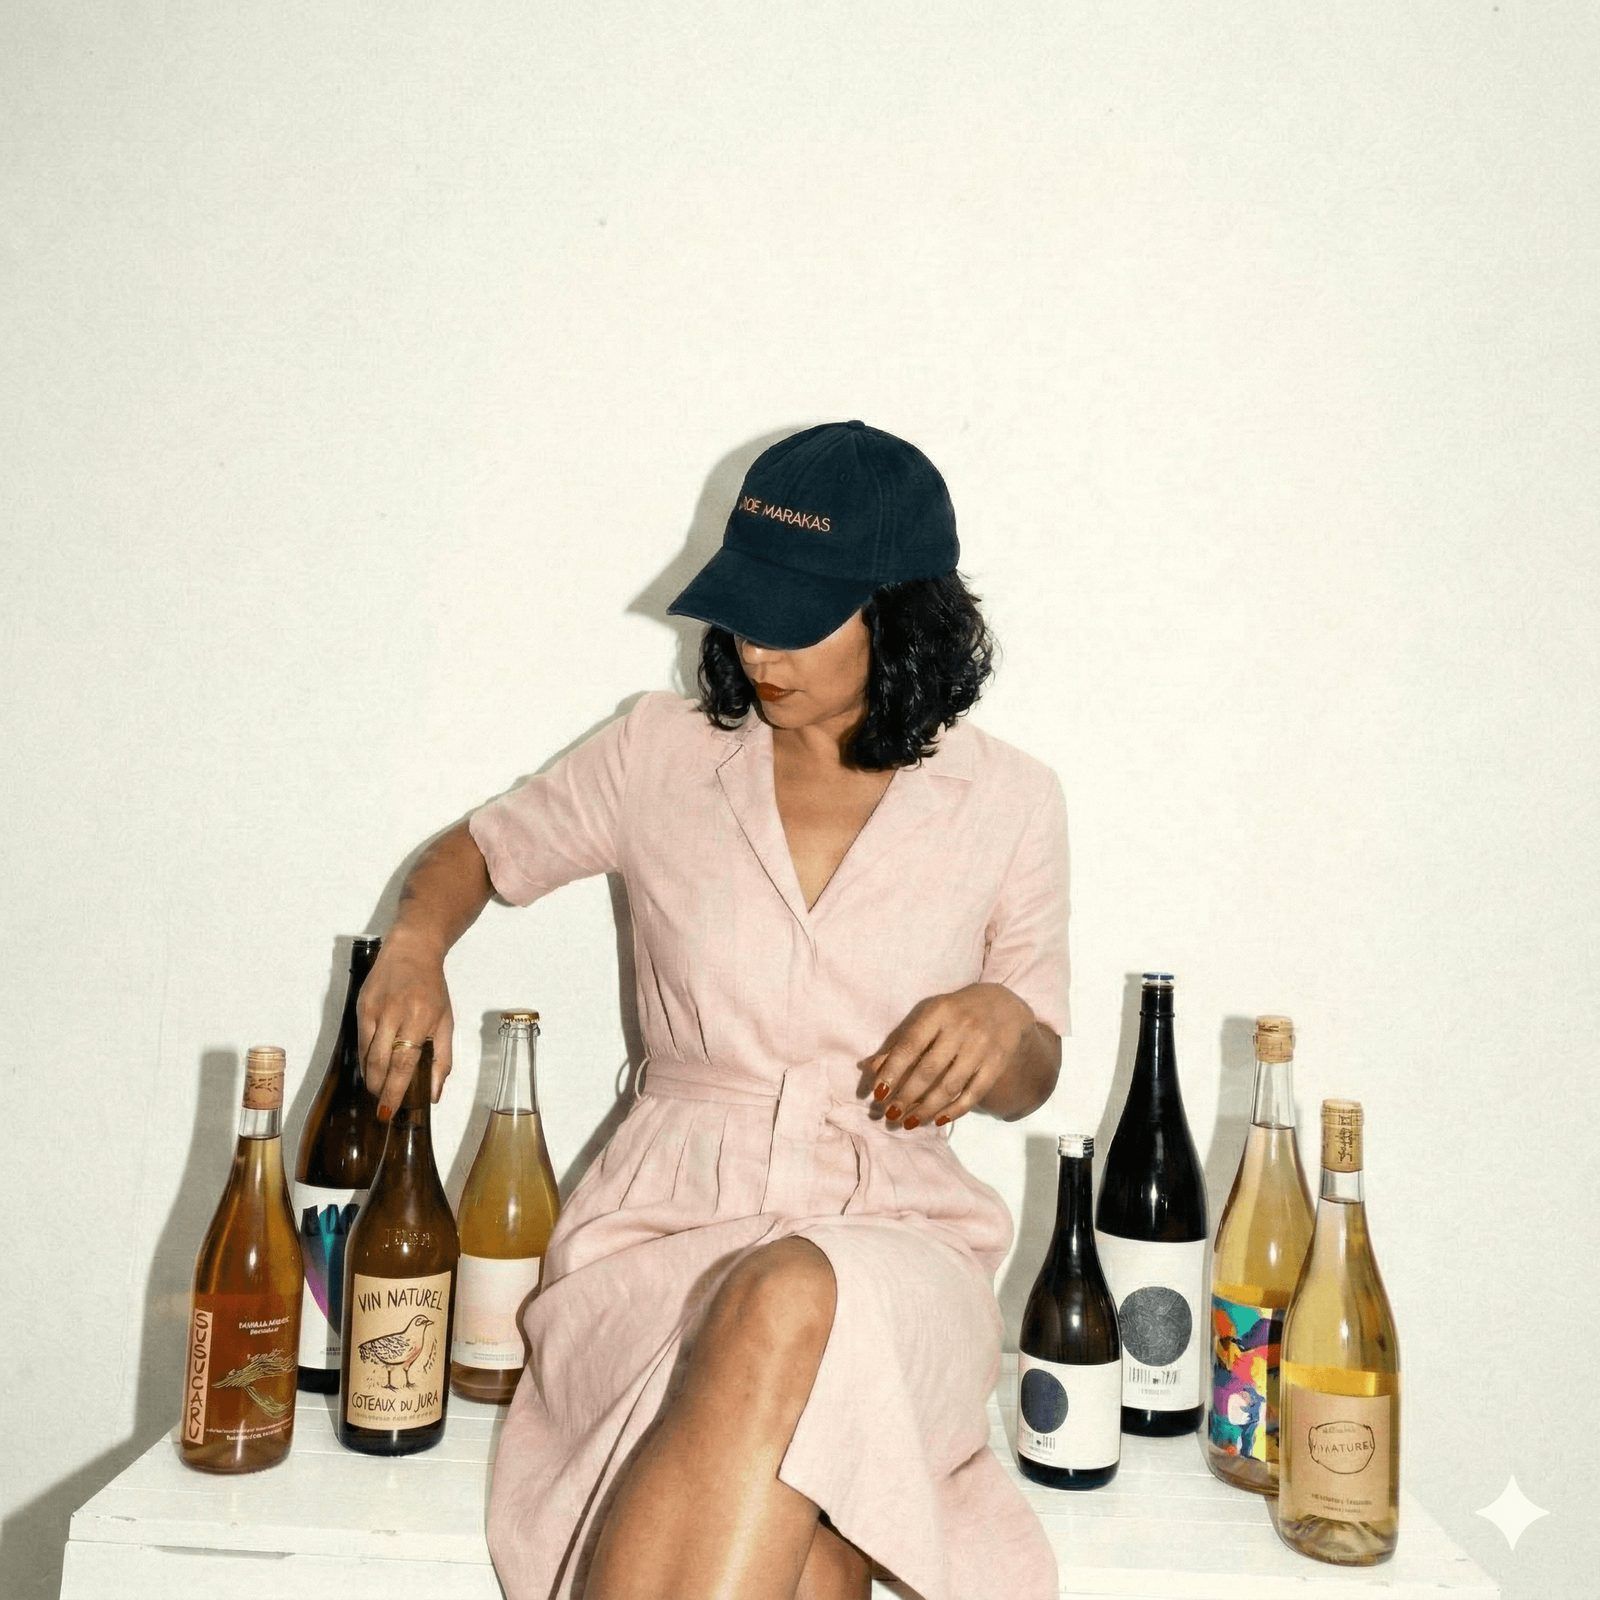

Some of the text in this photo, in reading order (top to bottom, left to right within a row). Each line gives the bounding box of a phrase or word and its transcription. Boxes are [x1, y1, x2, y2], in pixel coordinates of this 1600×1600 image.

[761, 504, 831, 532] MARAKAS
[358, 1288, 442, 1314] VIN NATUREL
[188, 1312, 209, 1440] SUSUCARU
[351, 1392, 396, 1412] COTEAUX
[413, 1389, 439, 1413] JURA
